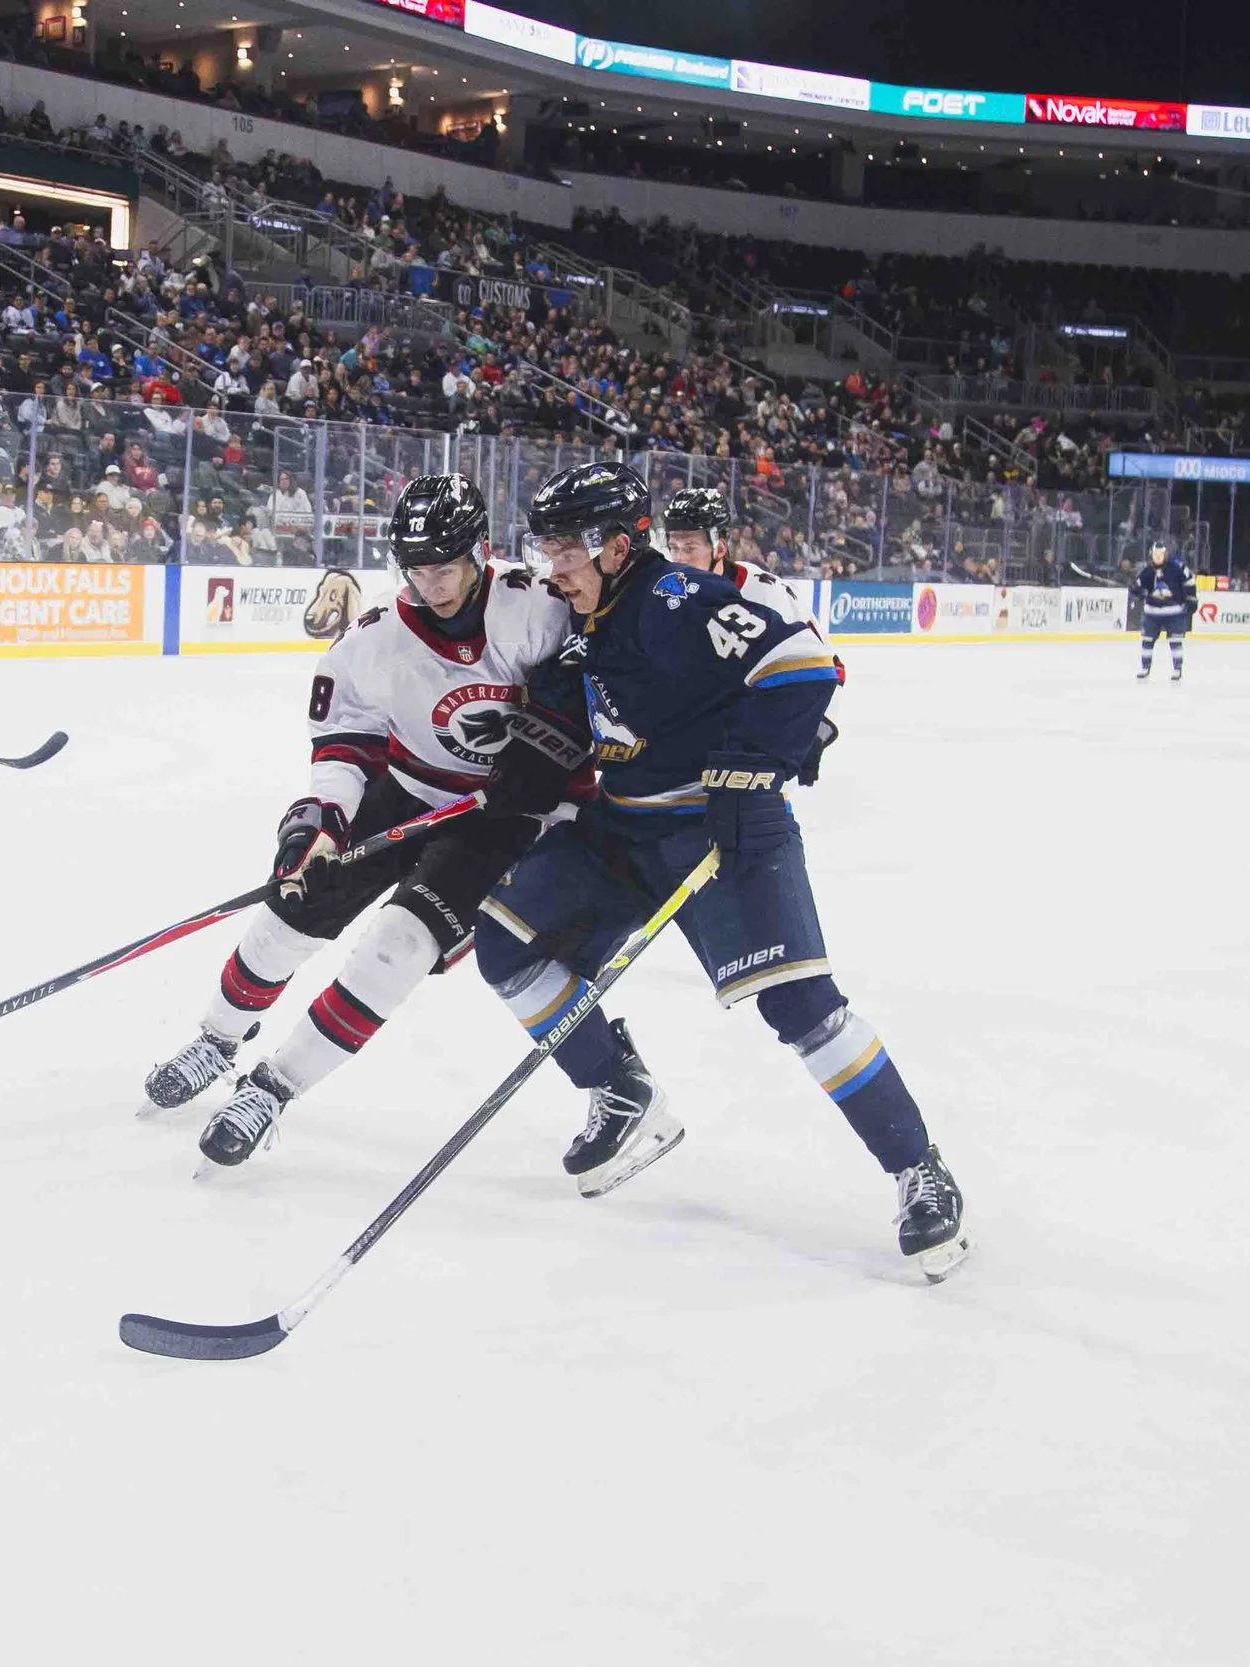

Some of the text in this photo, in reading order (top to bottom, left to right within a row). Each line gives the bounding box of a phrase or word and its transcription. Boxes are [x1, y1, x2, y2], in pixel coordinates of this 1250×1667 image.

[1047, 98, 1106, 124] Novak
[478, 279, 532, 311] CUSTOMS
[63, 567, 133, 595] FALLS
[239, 587, 310, 606] WIENER DOG
[851, 597, 912, 612] ORTHOPEDIC
[68, 598, 131, 626] CARE
[707, 602, 765, 660] 43
[411, 883, 466, 937] BAUER
[716, 944, 785, 984] BAUER
[547, 984, 601, 1045] BAUER
